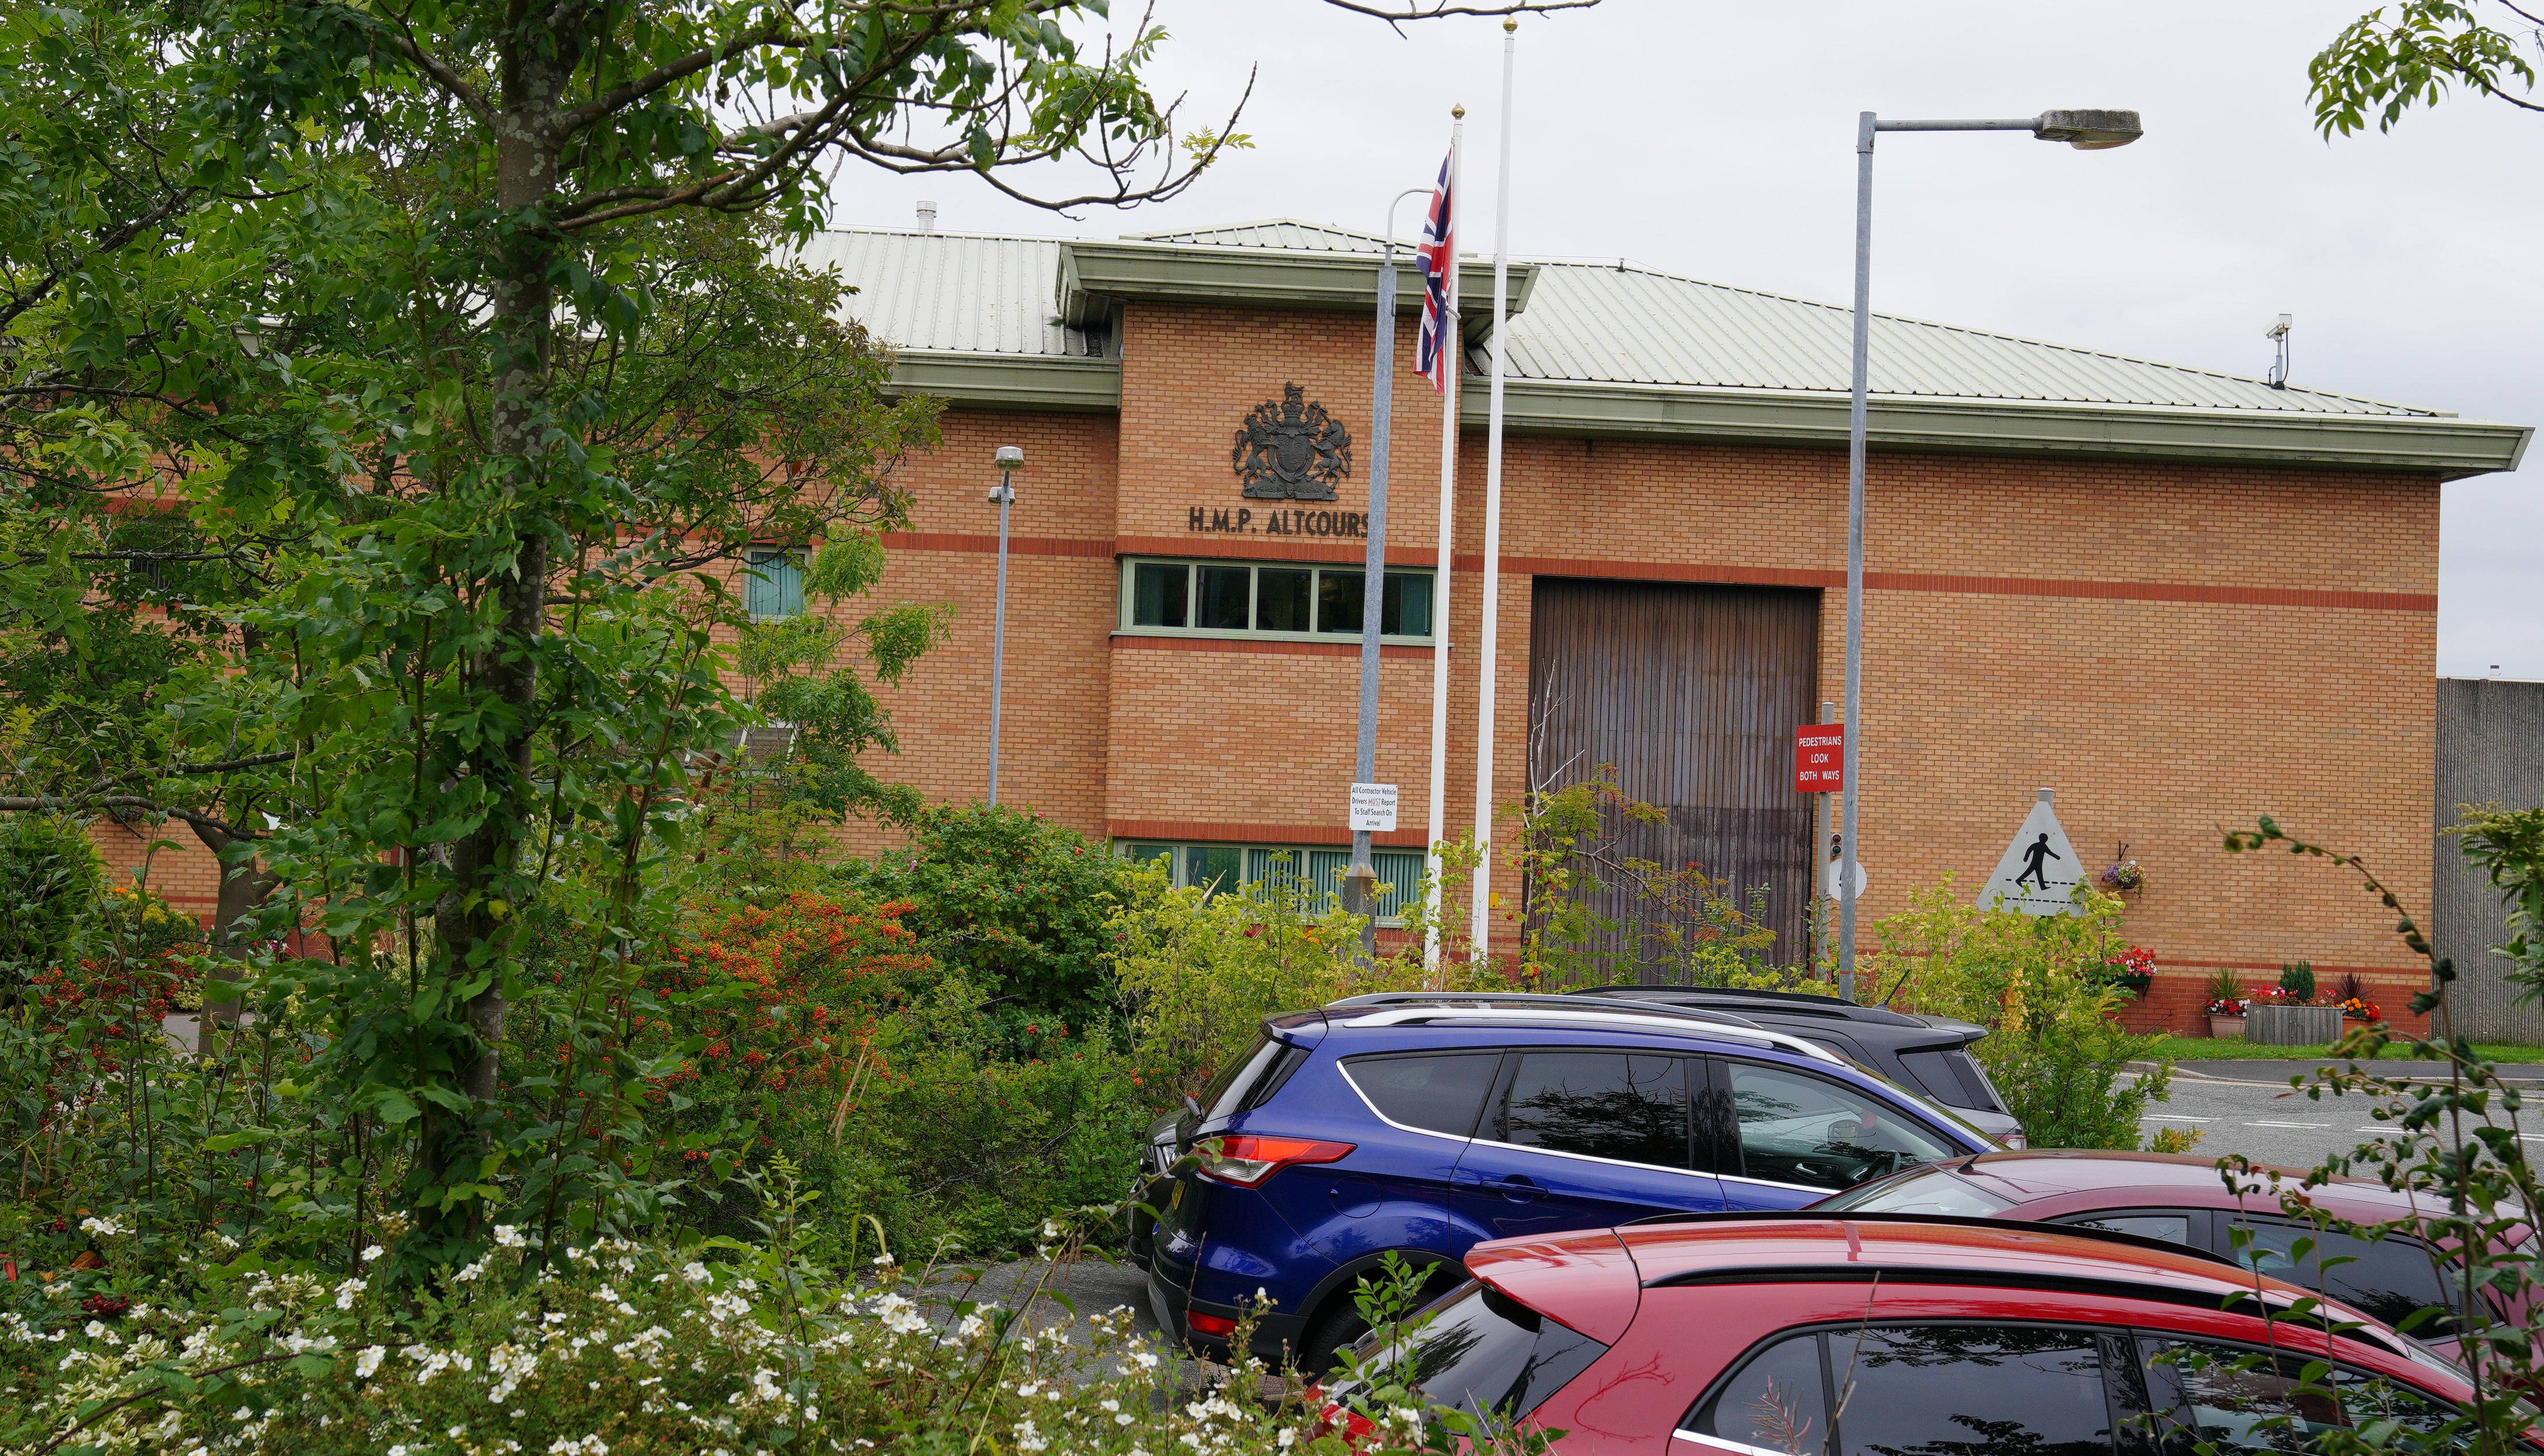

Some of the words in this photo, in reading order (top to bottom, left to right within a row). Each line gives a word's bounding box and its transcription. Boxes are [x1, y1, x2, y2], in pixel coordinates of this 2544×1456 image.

[1189, 507, 1257, 533] H.M.P.
[1799, 736, 1842, 747] PEDESTRIANS
[1811, 753, 1829, 764] LOOK
[1800, 771, 1817, 781] BOTH
[1822, 770, 1840, 780] WAYS
[1352, 797, 1367, 805] Drivers
[1381, 798, 1396, 806] Report
